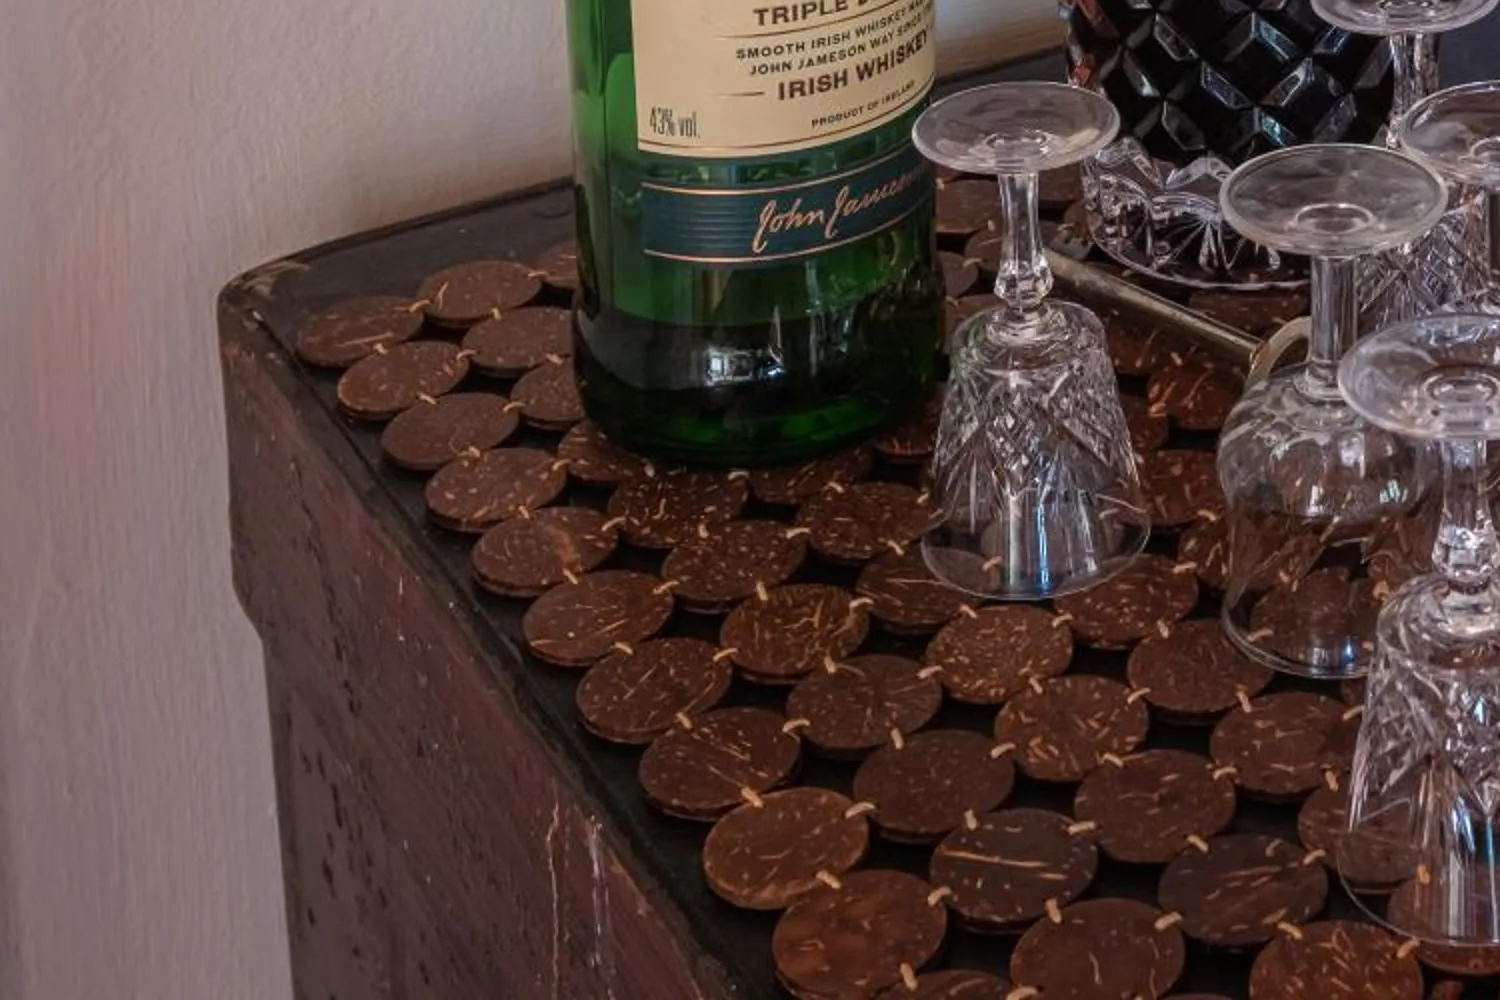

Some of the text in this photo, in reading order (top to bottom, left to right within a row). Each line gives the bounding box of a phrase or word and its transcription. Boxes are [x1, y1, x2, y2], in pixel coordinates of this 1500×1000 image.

[736, 42, 805, 60] SMOOTH
[811, 30, 850, 49] IRISH
[855, 7, 906, 37] WHISKEY
[750, 60, 793, 76] JOHN
[798, 43, 866, 70] JAMESON
[869, 30, 894, 49] WAY
[778, 25, 929, 100] IRISH WHISKEY
[650, 107, 676, 137] 43%
[812, 80, 915, 128] PRODUCT OF IRELAND
[752, 197, 824, 253] John
